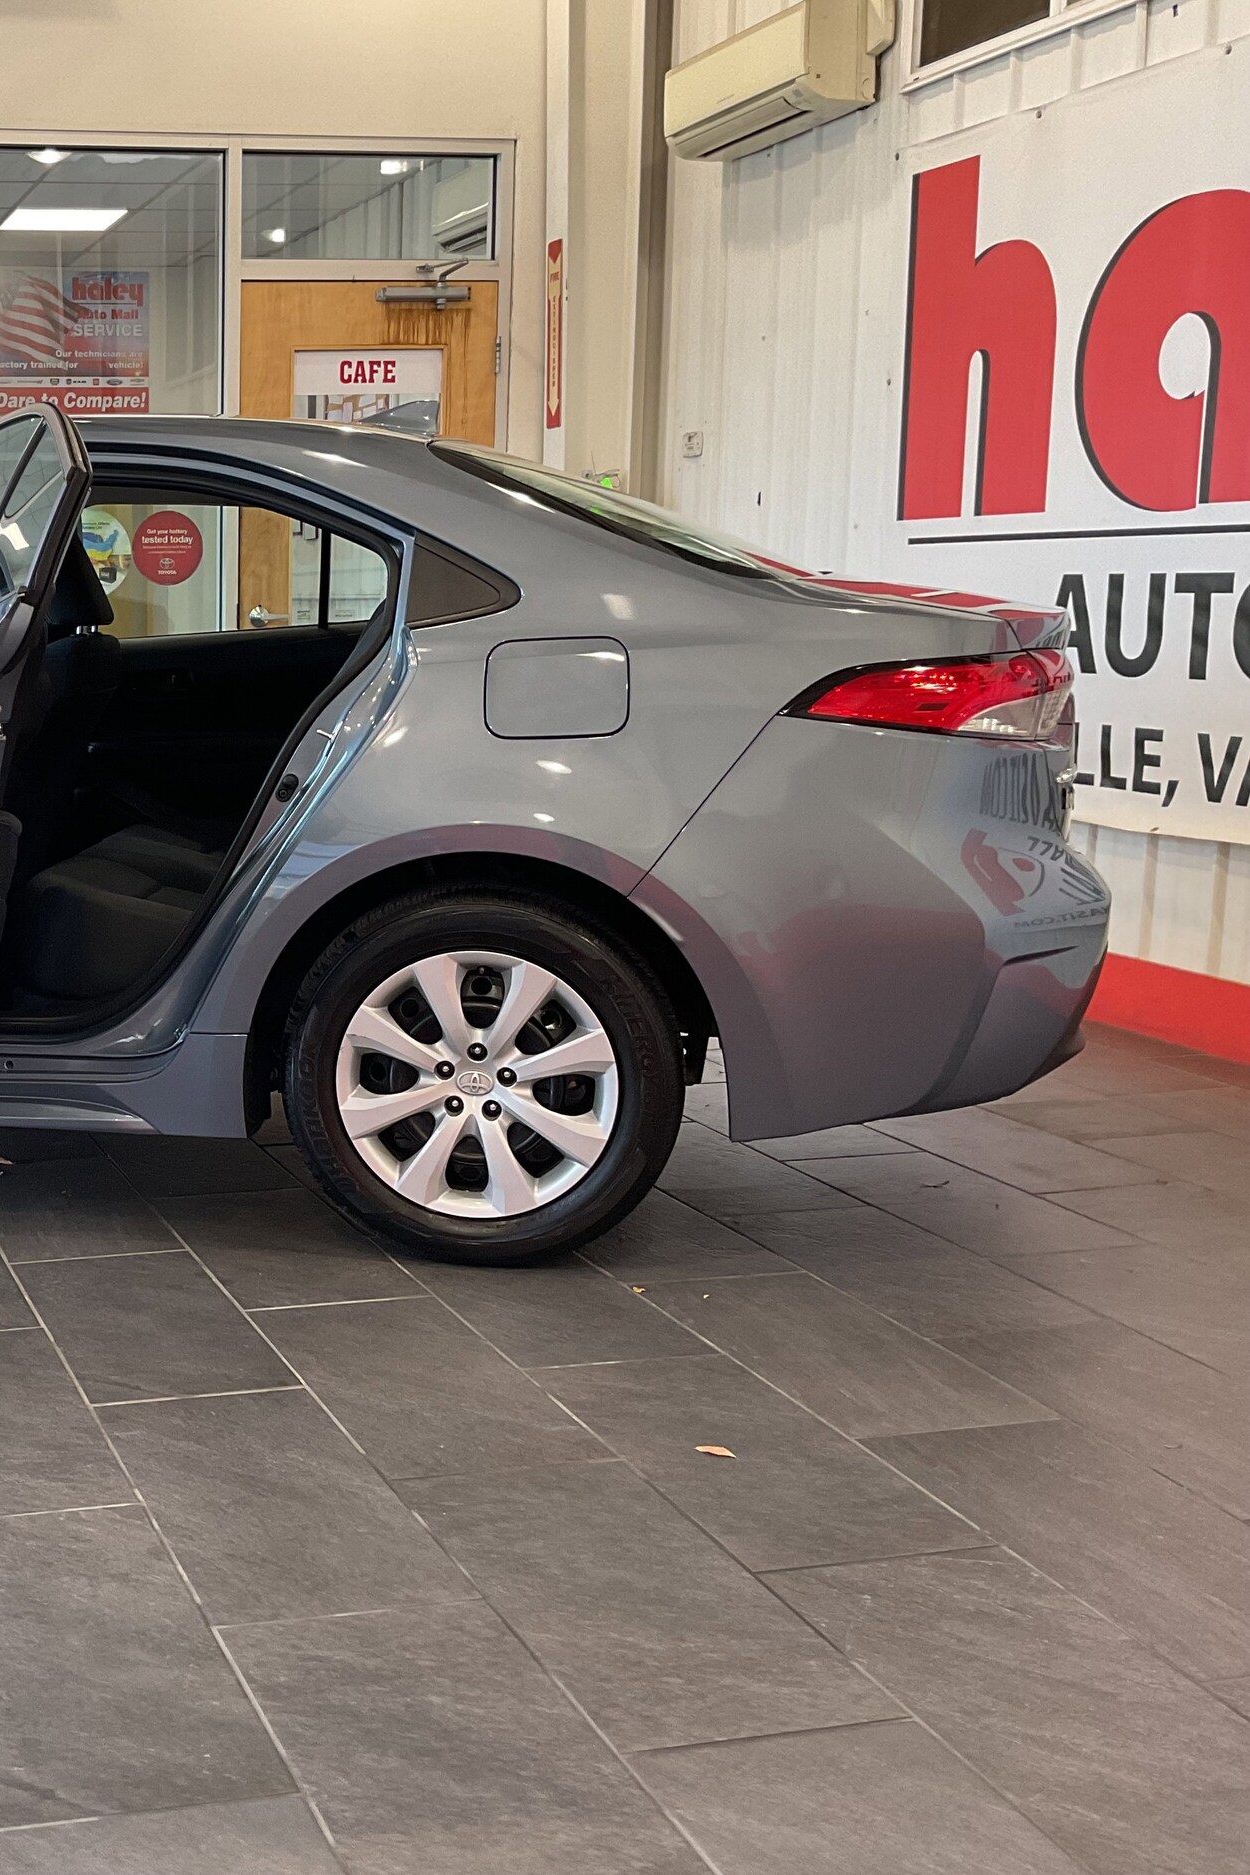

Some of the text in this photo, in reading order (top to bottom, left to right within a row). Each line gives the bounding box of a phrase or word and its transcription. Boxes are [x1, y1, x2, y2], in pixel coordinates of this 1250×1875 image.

[72, 277, 144, 307] haley
[111, 309, 139, 320] Mall
[73, 324, 143, 337] SERVICE
[55, 350, 71, 358] Our
[74, 350, 126, 358] technicians
[30, 361, 62, 369] trained
[65, 361, 79, 369] for
[339, 360, 396, 384] CAFE
[63, 392, 147, 412] Compare!
[141, 535, 194, 545] tested today
[1056, 572, 1250, 681] AUT
